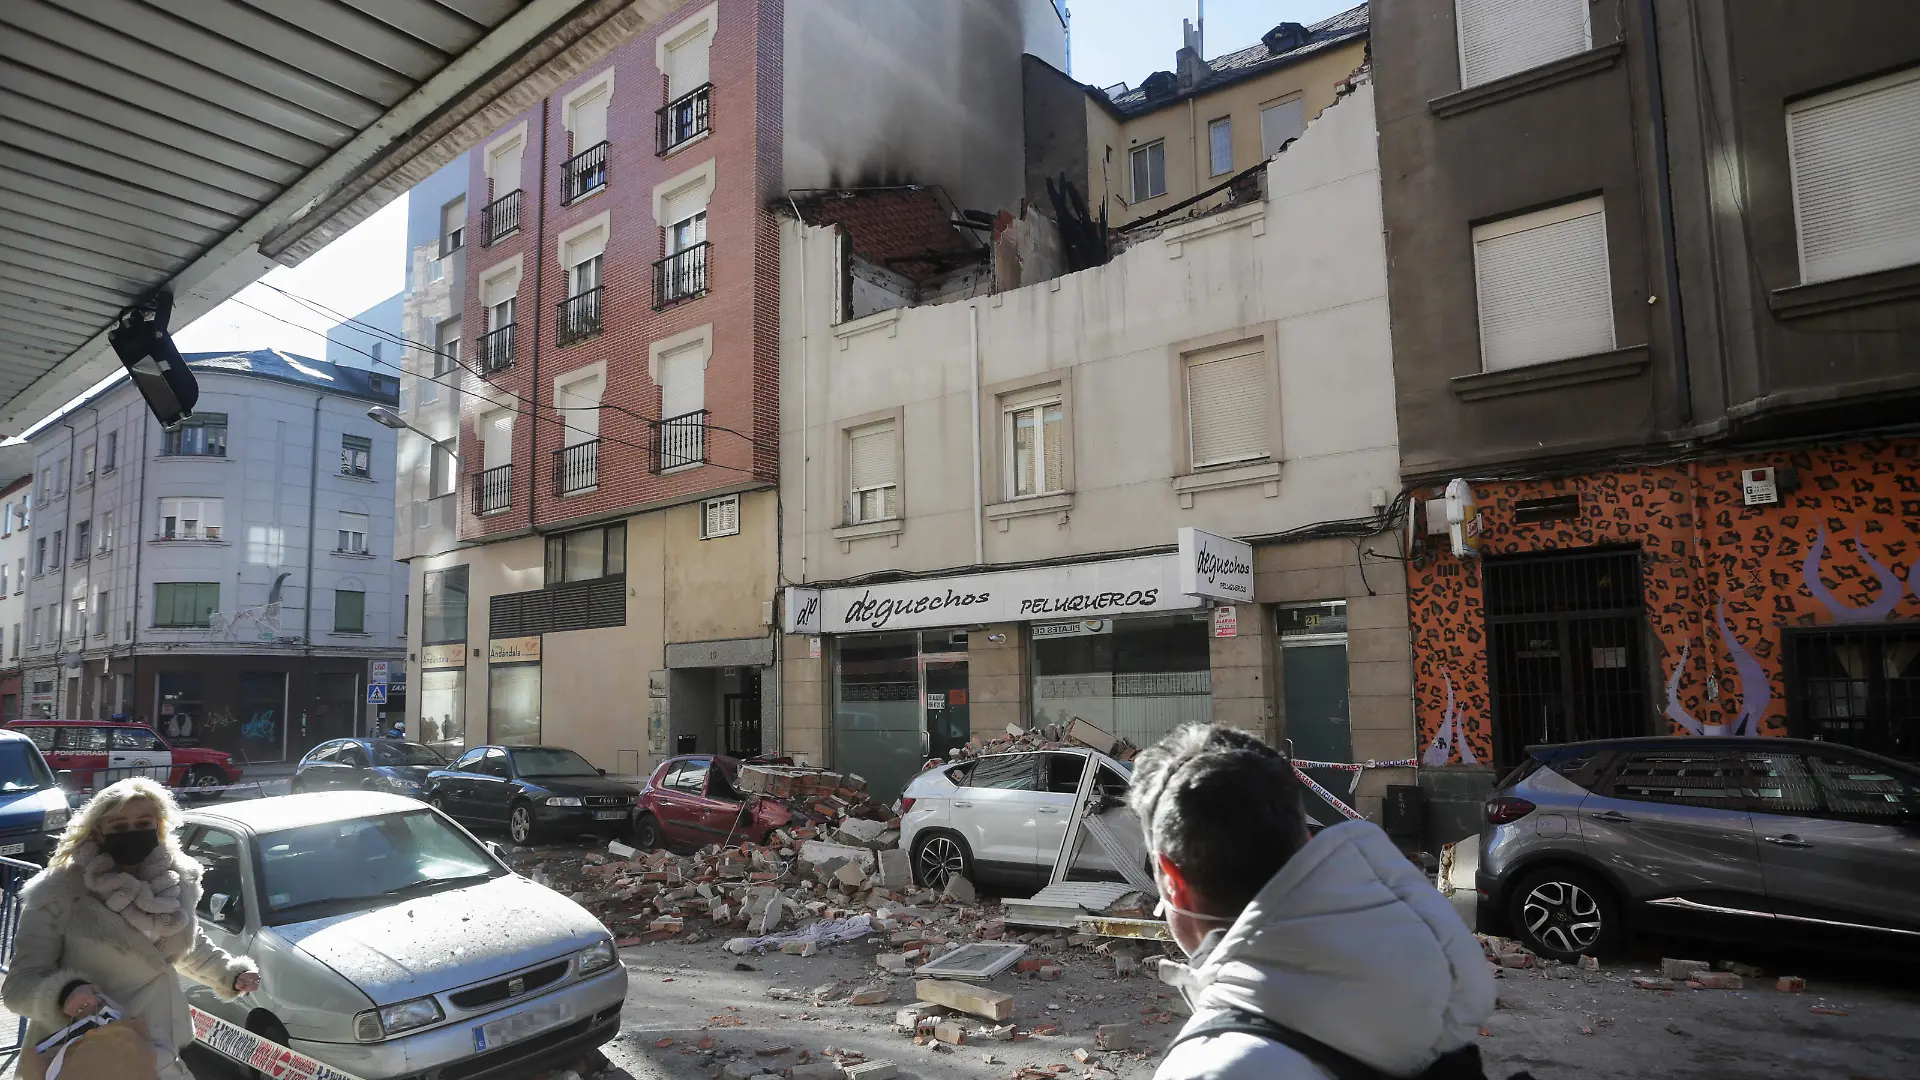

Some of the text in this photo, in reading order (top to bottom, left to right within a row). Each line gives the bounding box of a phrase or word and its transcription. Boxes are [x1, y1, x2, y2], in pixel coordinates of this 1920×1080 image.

[1197, 540, 1250, 584] deguechos
[844, 588, 1159, 628] deguechos PELUQUEROS
[1306, 615, 1318, 625] 21
[1292, 760, 1308, 768] ASAR
[1294, 769, 1363, 820] PASAR POLICIA NO PASA
